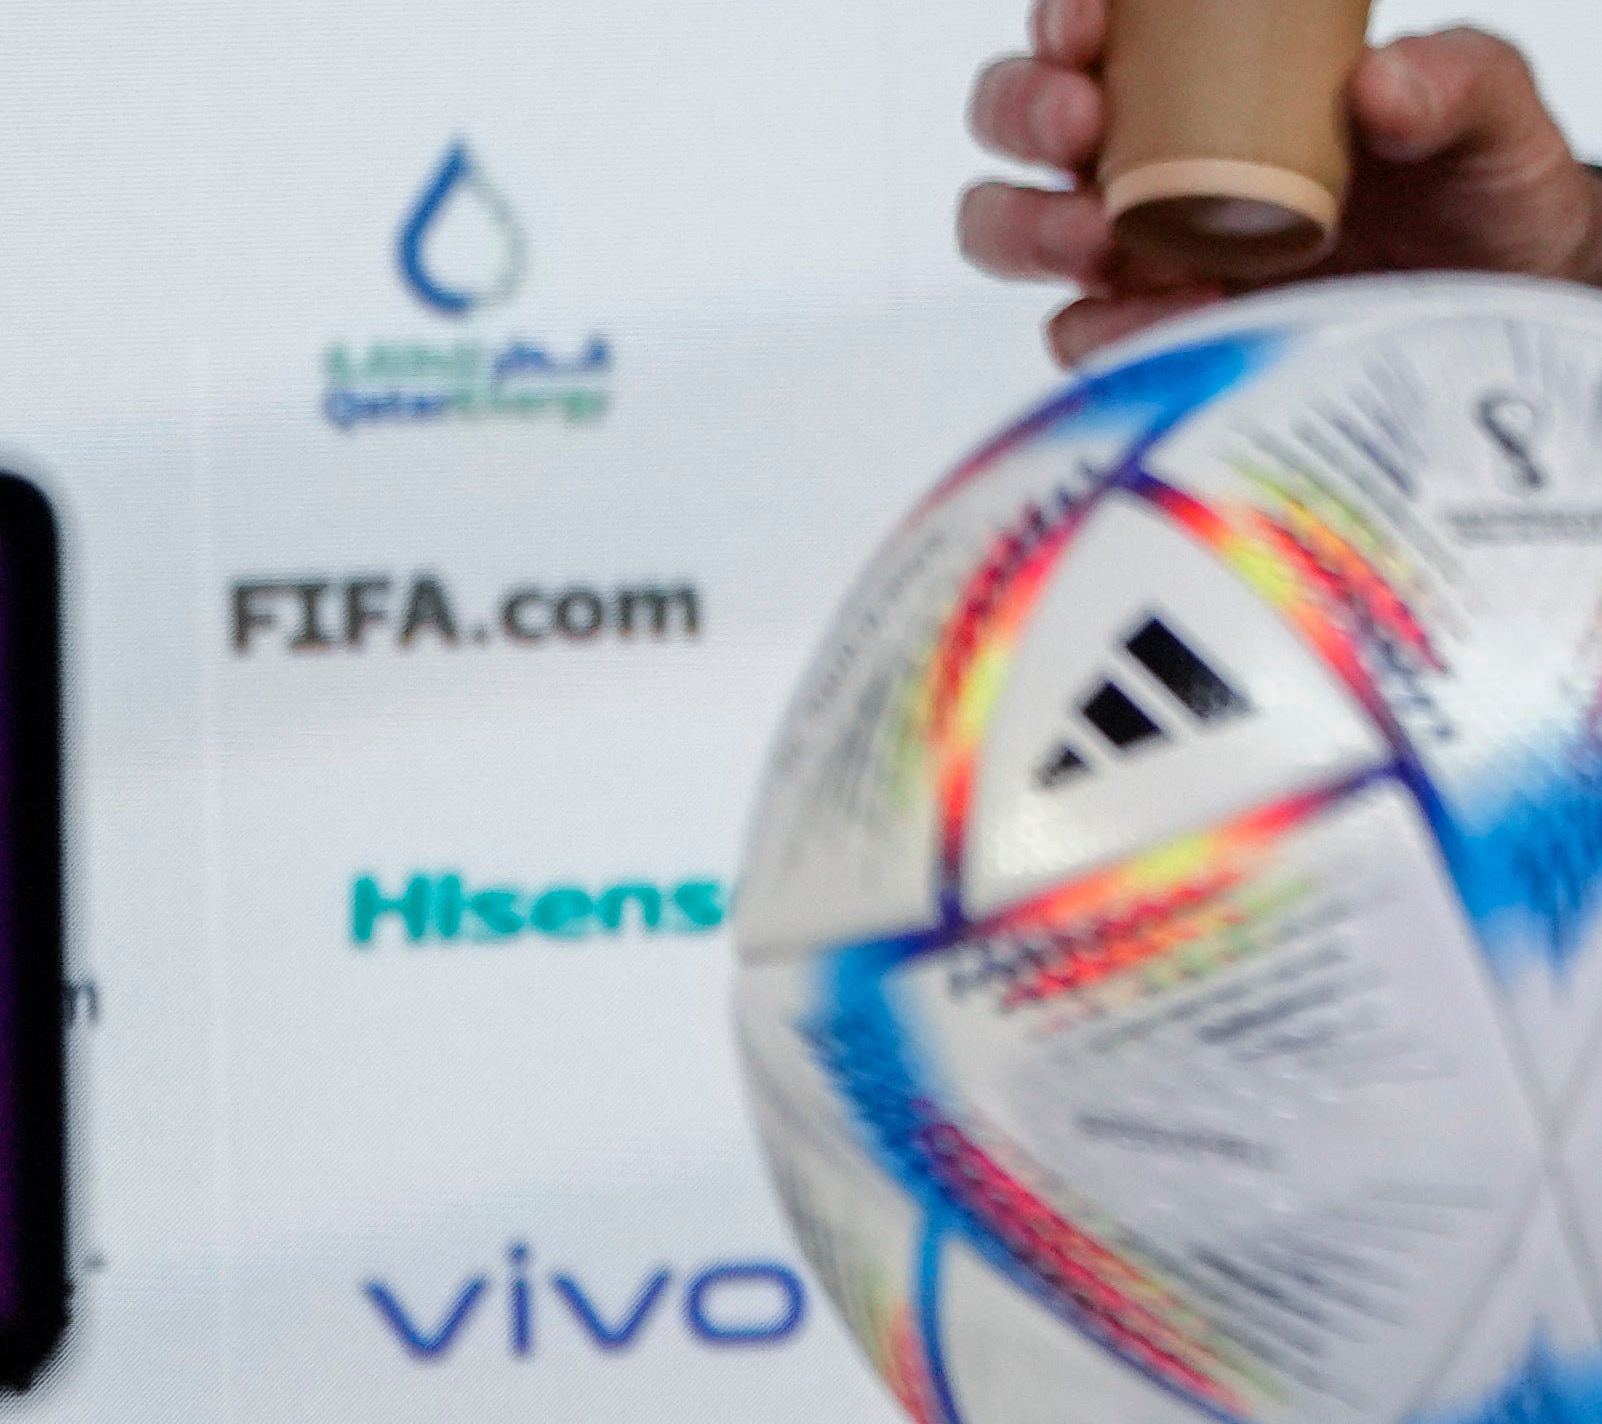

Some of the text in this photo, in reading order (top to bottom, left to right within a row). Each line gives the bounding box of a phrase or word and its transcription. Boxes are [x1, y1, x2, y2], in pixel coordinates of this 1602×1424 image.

[228, 571, 706, 657] FIFA.com
[348, 869, 730, 947] Hisens
[362, 1237, 812, 1363] vivo
